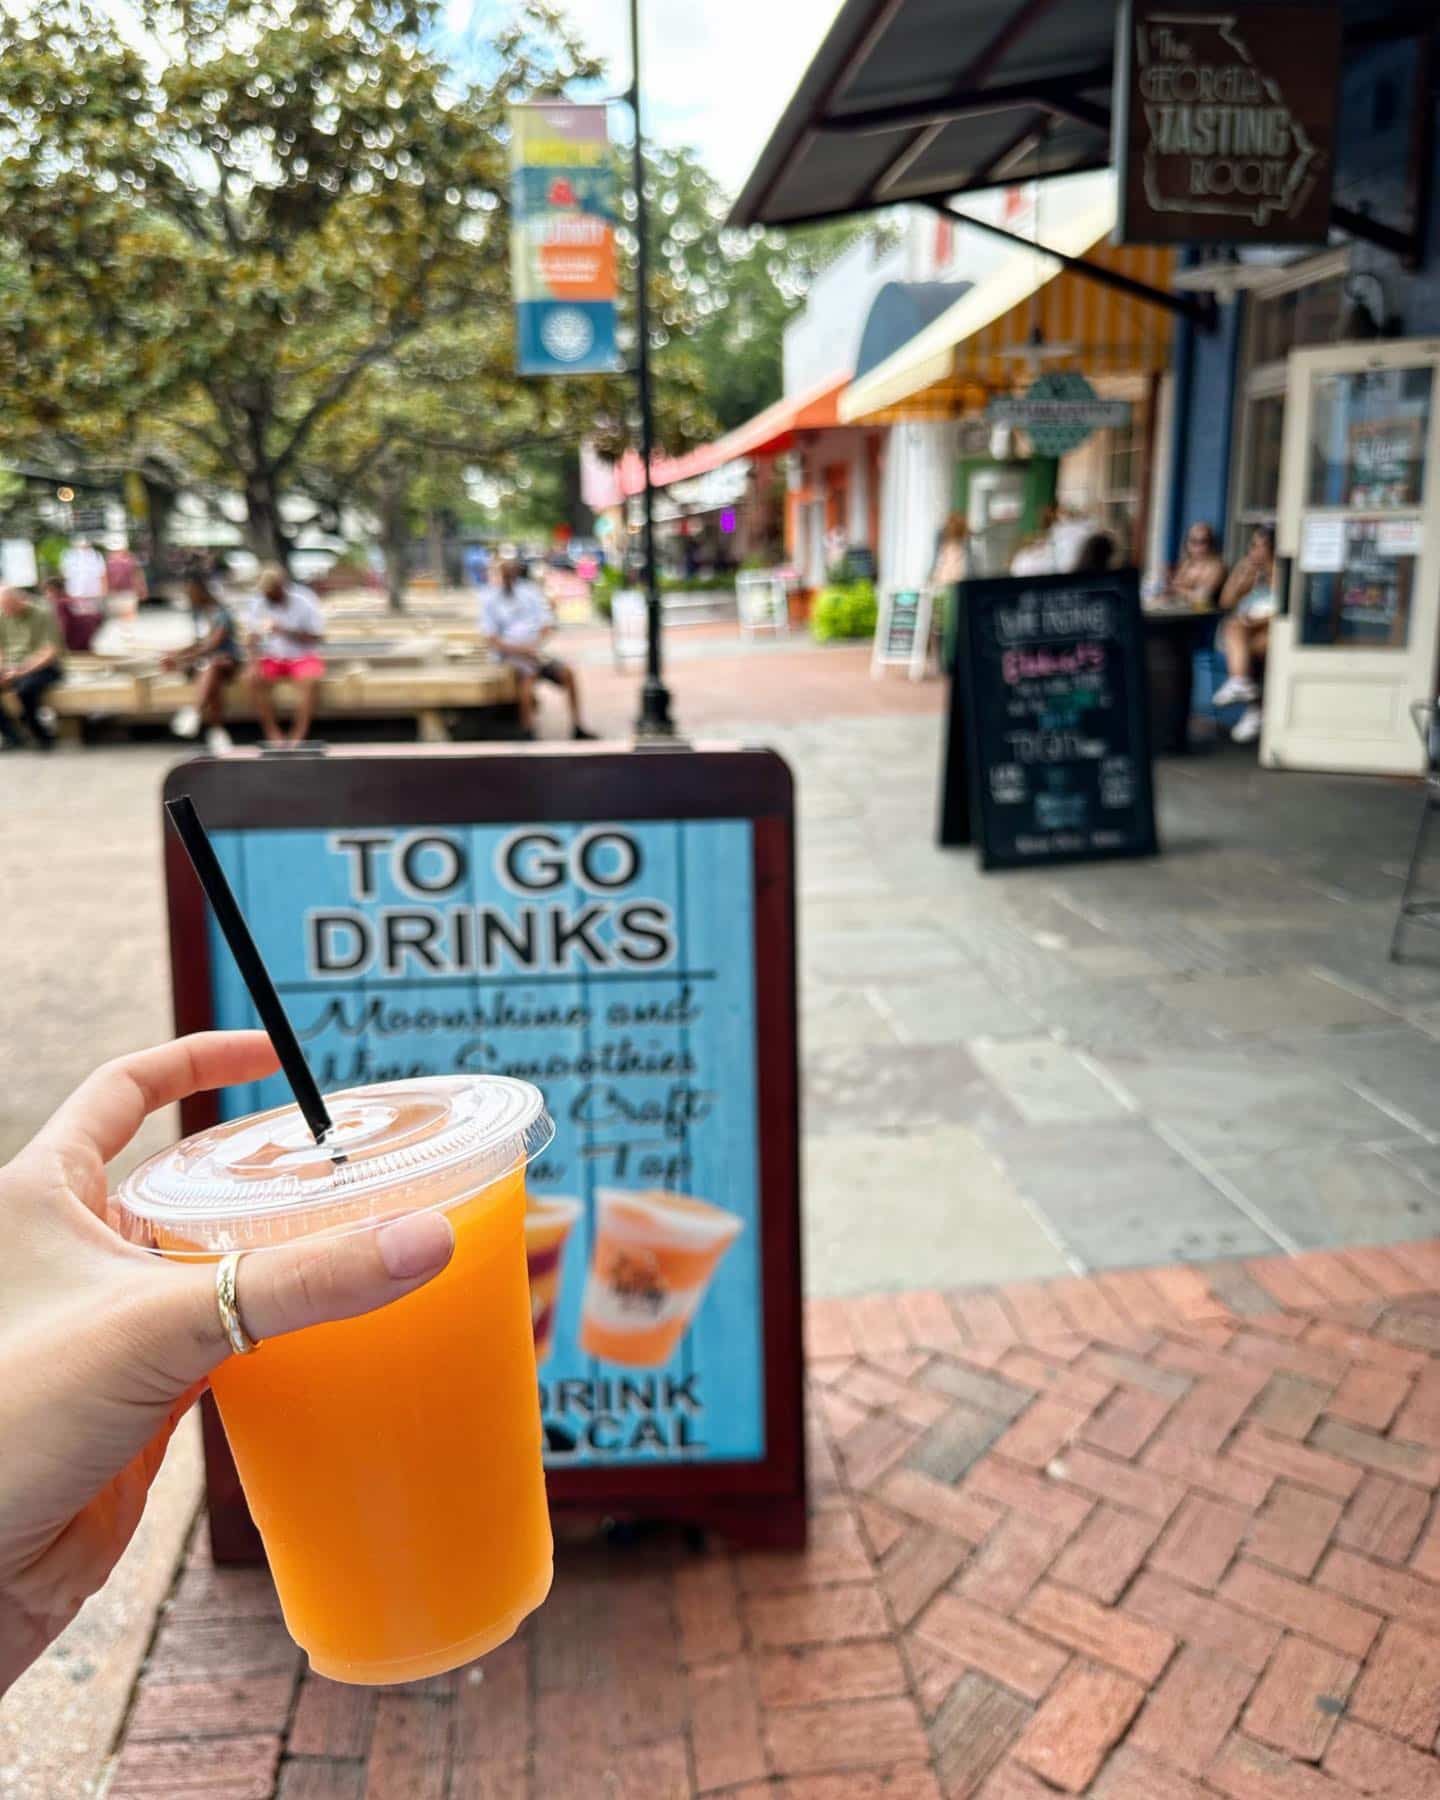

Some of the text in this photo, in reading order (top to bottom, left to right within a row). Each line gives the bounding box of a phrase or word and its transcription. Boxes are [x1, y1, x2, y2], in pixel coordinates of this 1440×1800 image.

[1150, 104, 1291, 156] TASTING
[329, 824, 645, 899] TO GO
[308, 901, 674, 978] DRINKS
[606, 984, 702, 1027] and
[568, 1083, 718, 1142] Craft
[577, 1139, 694, 1190] Tap
